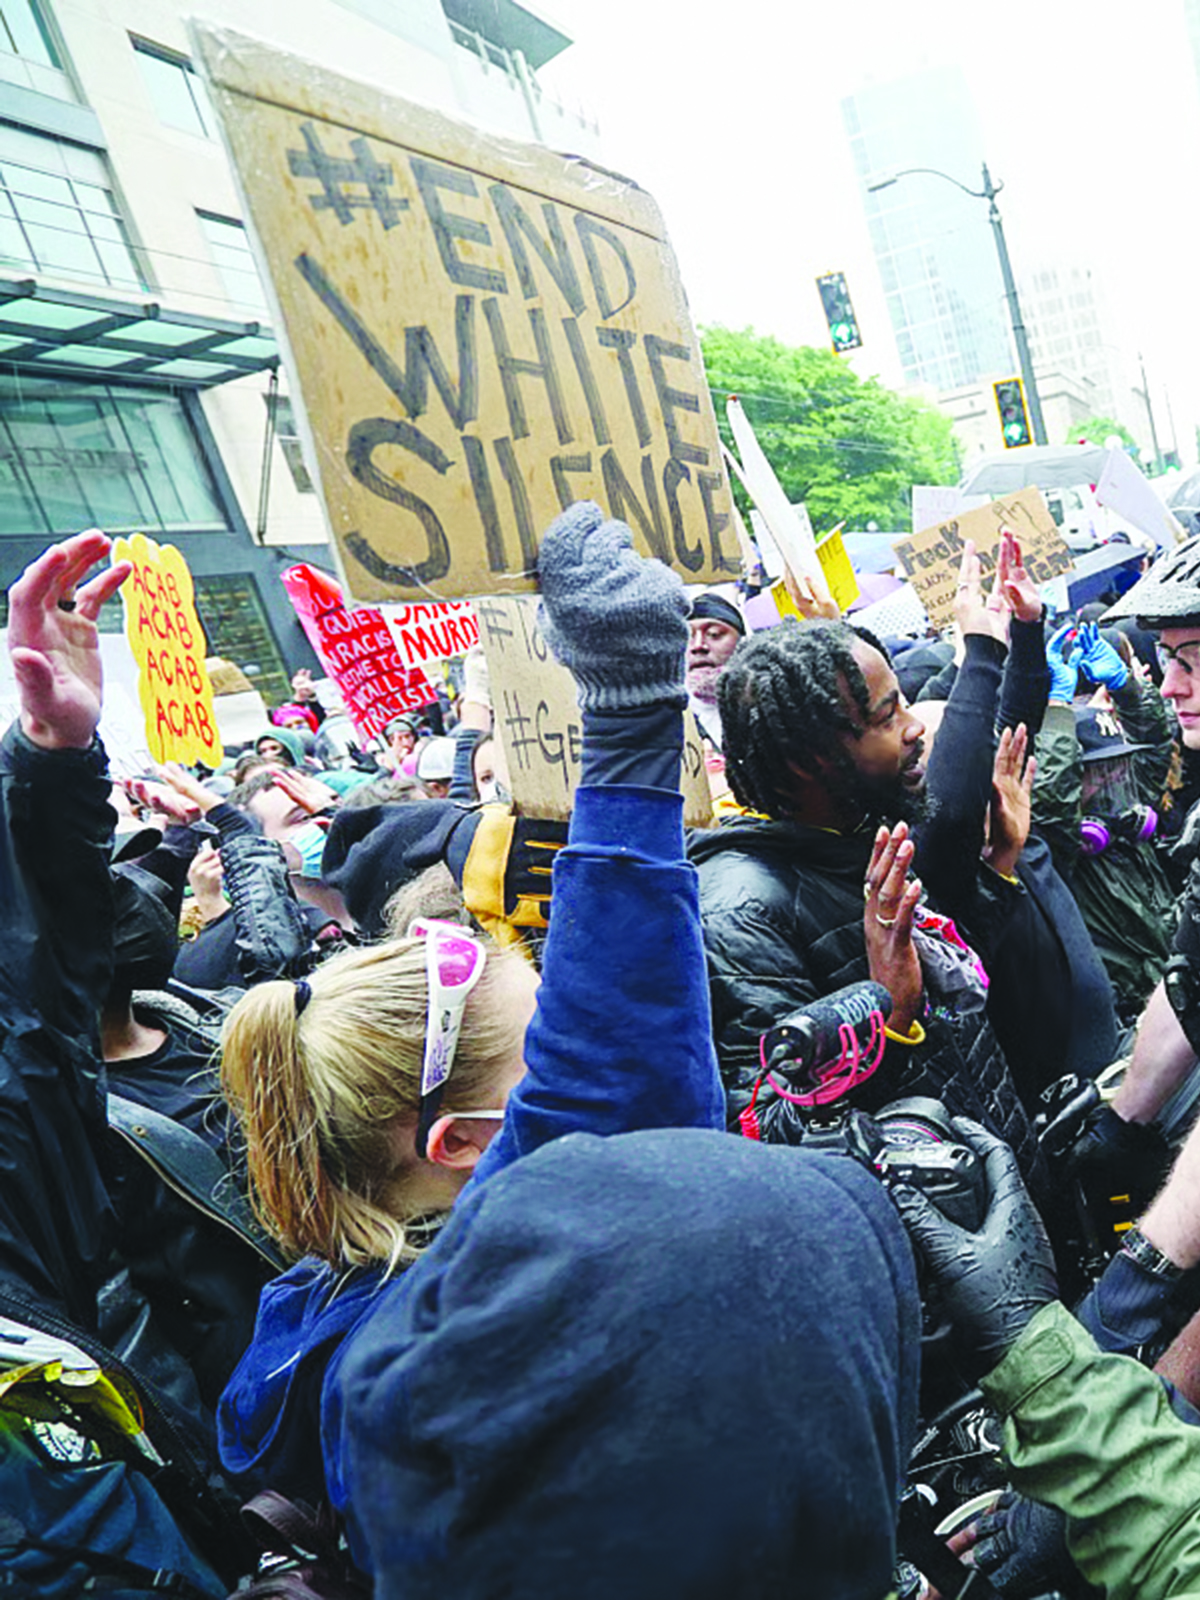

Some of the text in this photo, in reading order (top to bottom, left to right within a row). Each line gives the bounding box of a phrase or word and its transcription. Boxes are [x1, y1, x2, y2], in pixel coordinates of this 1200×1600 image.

[286, 120, 638, 320] #END
[294, 251, 710, 466] WHITE
[131, 560, 182, 609] ACAB
[138, 602, 194, 651] ACAB
[147, 647, 203, 695] ACAB
[156, 697, 214, 749] ACAB
